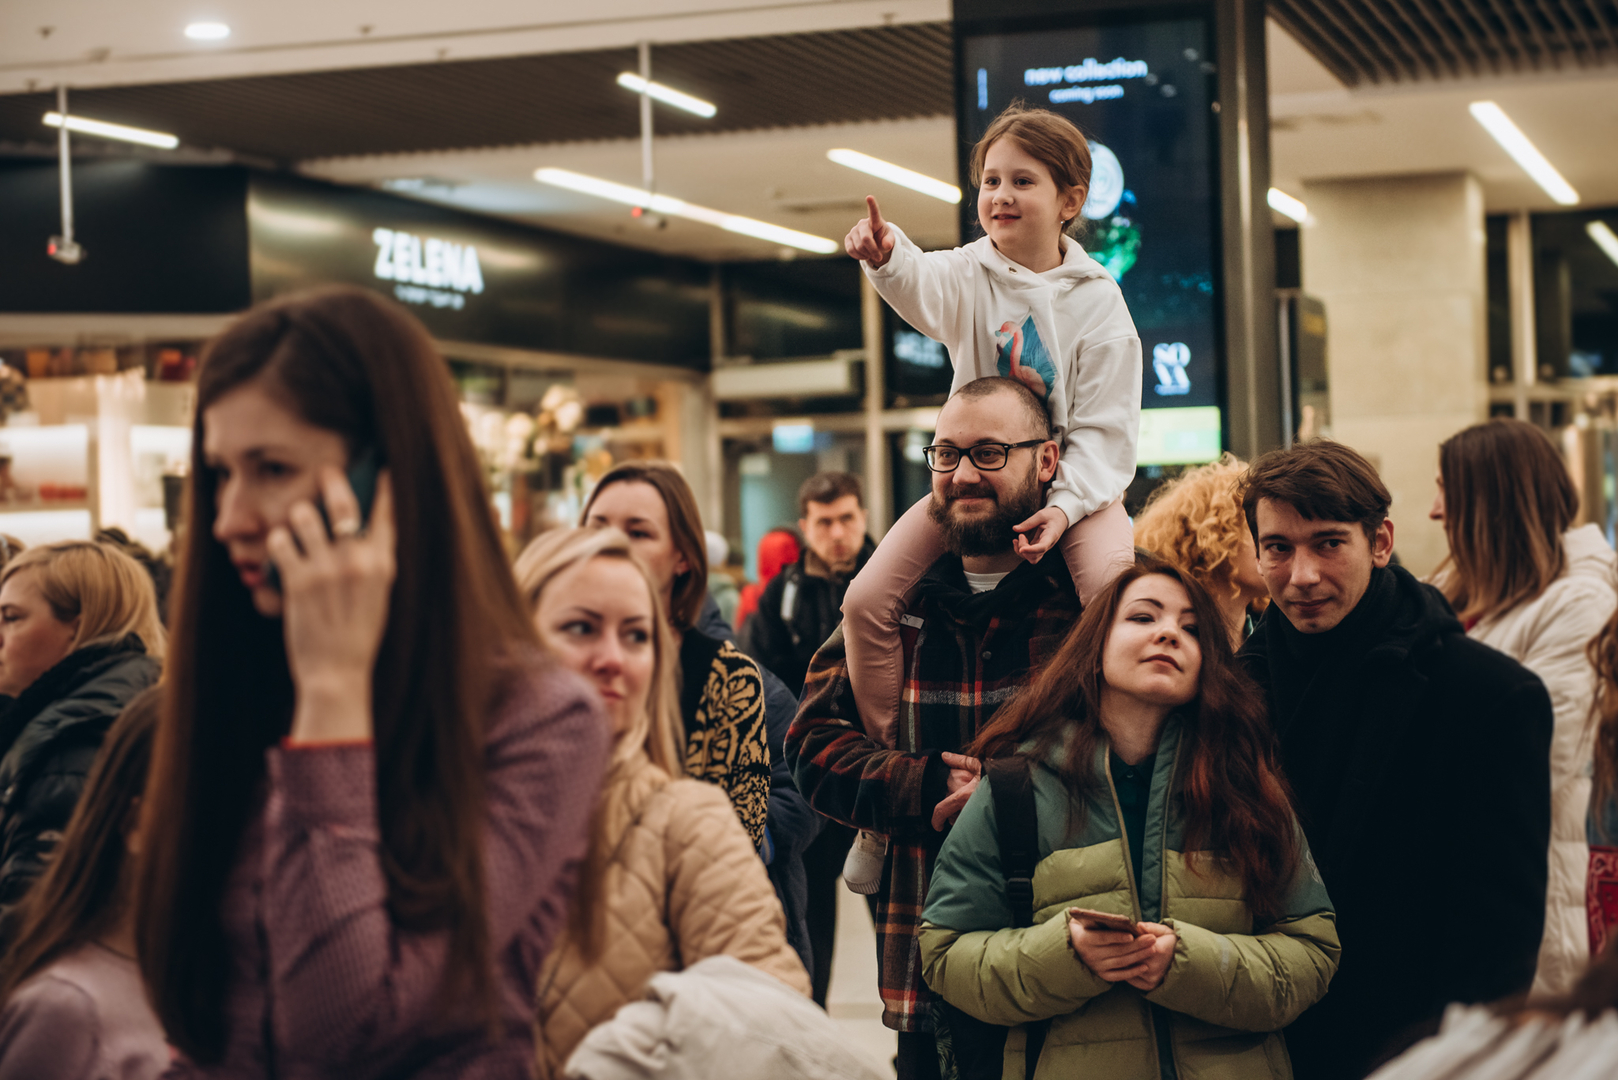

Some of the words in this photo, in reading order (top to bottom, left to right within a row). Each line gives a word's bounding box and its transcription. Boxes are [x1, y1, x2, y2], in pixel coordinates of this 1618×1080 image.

[1024, 66, 1063, 87] new
[1064, 56, 1148, 84] collection
[1049, 85, 1094, 105] coming
[373, 227, 485, 294] ZELENA
